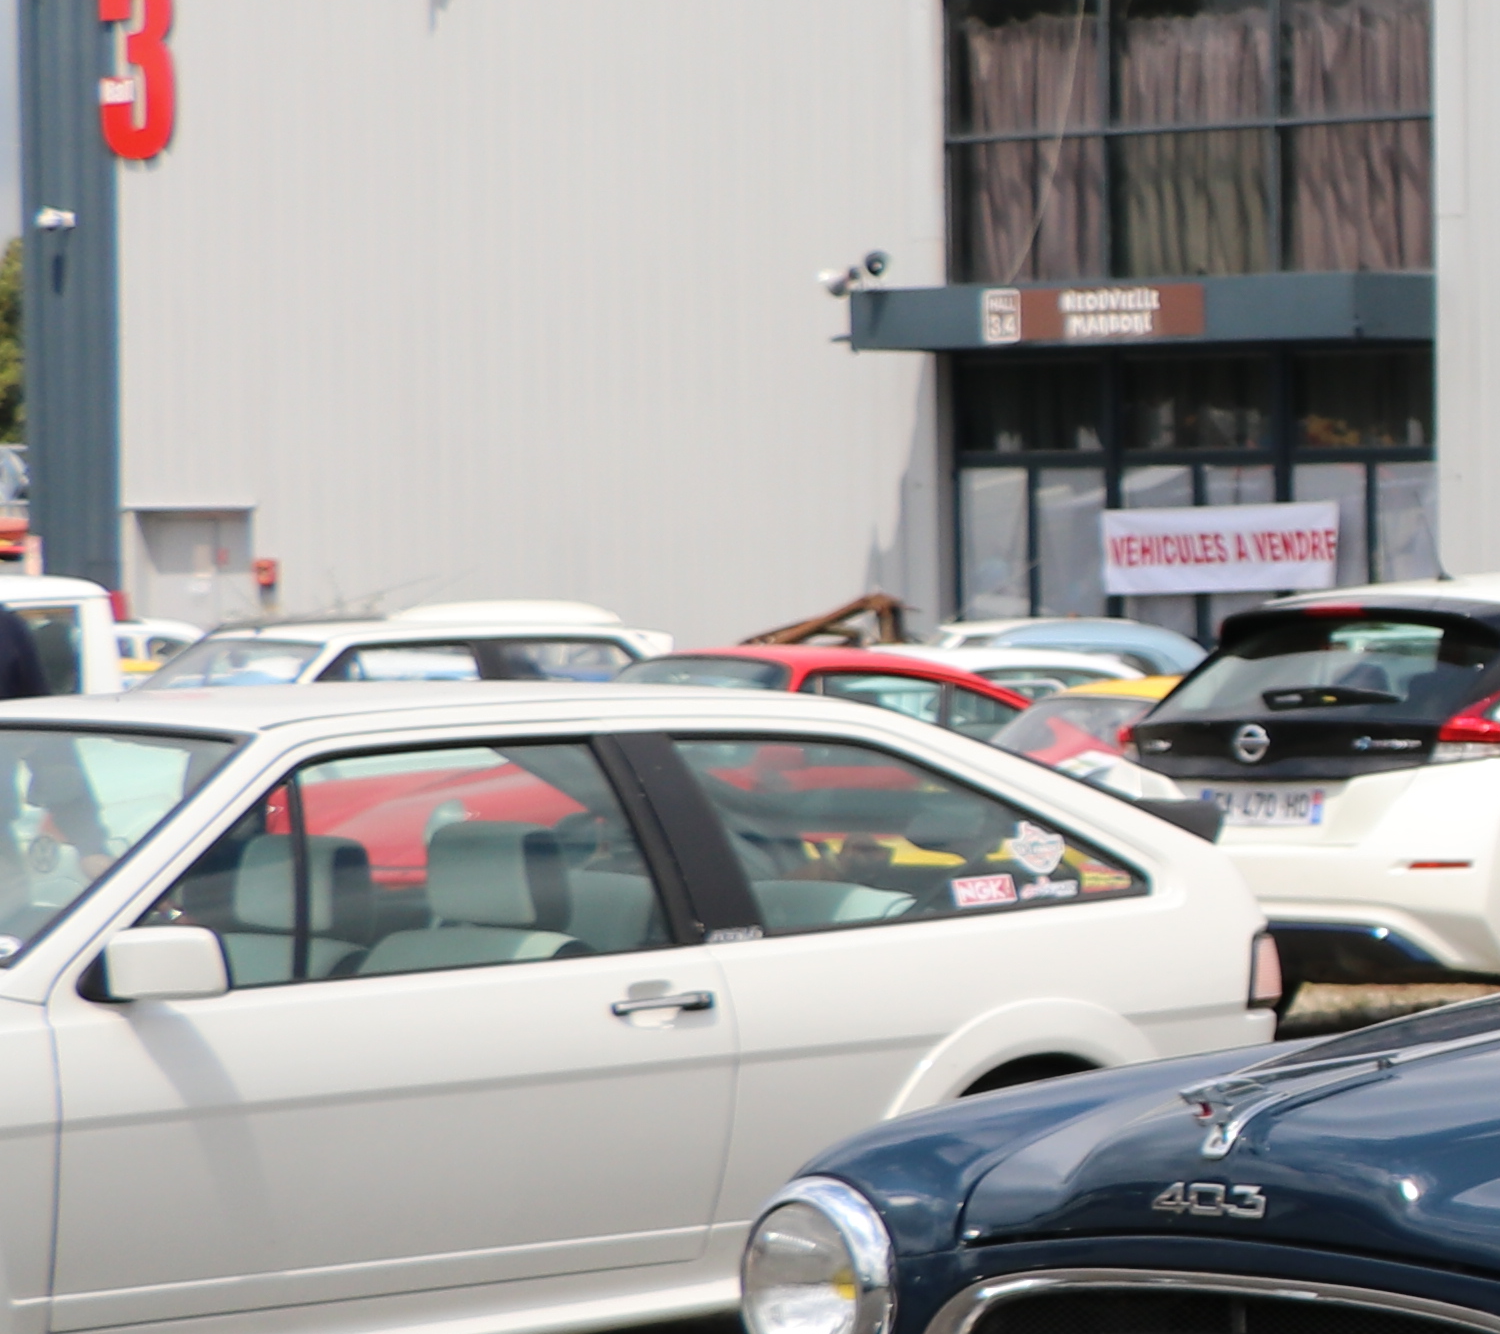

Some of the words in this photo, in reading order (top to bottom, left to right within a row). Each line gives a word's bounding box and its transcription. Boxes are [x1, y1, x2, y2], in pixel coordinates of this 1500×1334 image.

[989, 296, 1015, 312] HALL
[1110, 533, 1227, 566] VEHICULES
[1234, 533, 1248, 561] A
[1252, 528, 1337, 562] VENDRE
[959, 878, 1008, 903] NGK
[1151, 1181, 1266, 1219] 403
